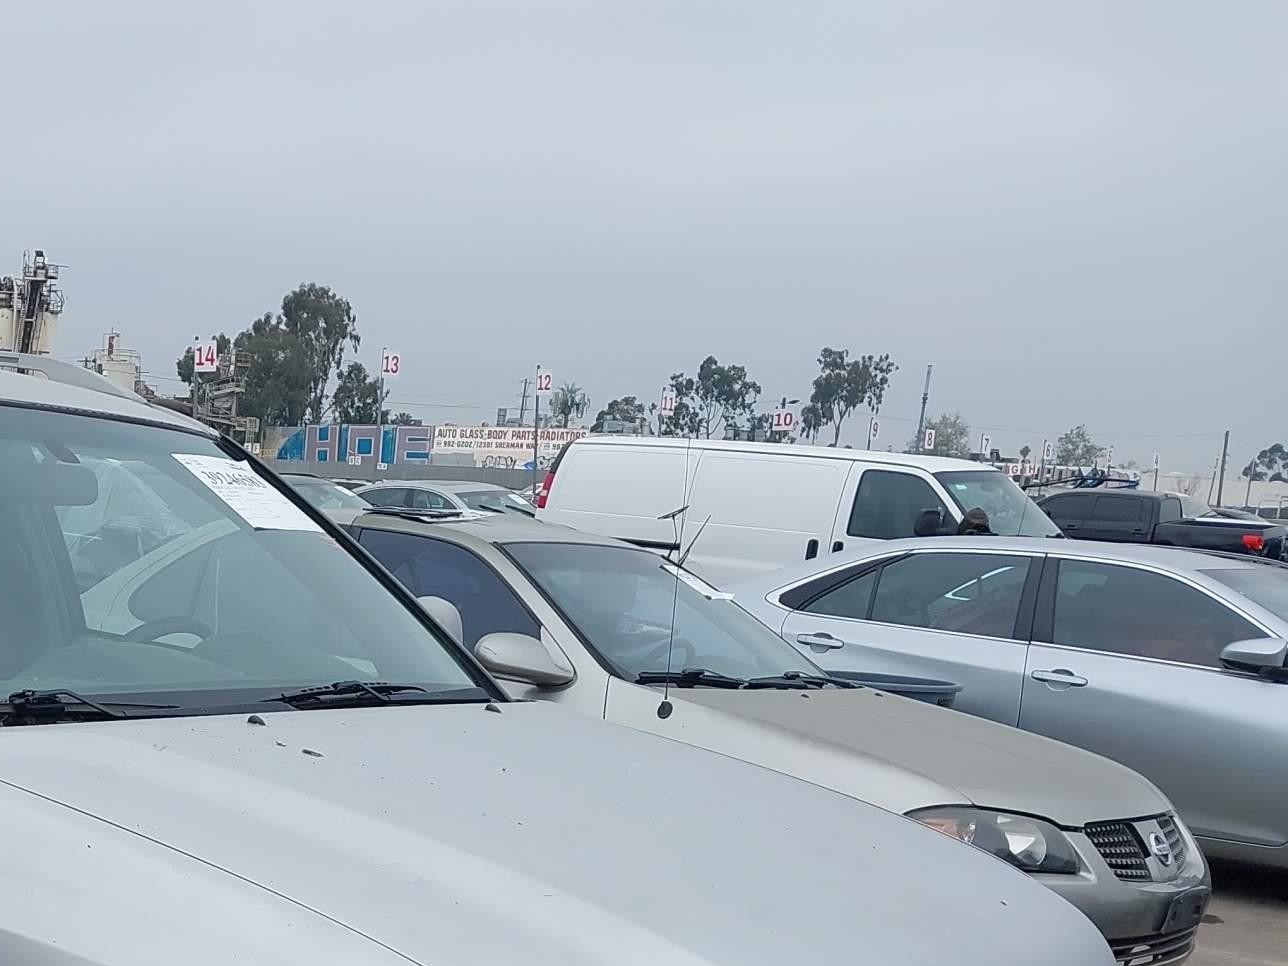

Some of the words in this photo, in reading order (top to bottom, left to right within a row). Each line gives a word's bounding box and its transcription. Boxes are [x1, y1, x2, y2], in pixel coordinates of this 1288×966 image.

[196, 346, 216, 366] 14
[383, 355, 399, 374] 13
[538, 375, 551, 390] 12
[662, 396, 674, 411] 11
[774, 412, 793, 427] 10
[437, 428, 457, 438] AUTO
[872, 422, 879, 437] 9
[926, 432, 933, 447] 8
[984, 438, 990, 452] 7
[1045, 444, 1051, 458] 6
[1011, 465, 1019, 474] G
[1028, 465, 1035, 474] H
